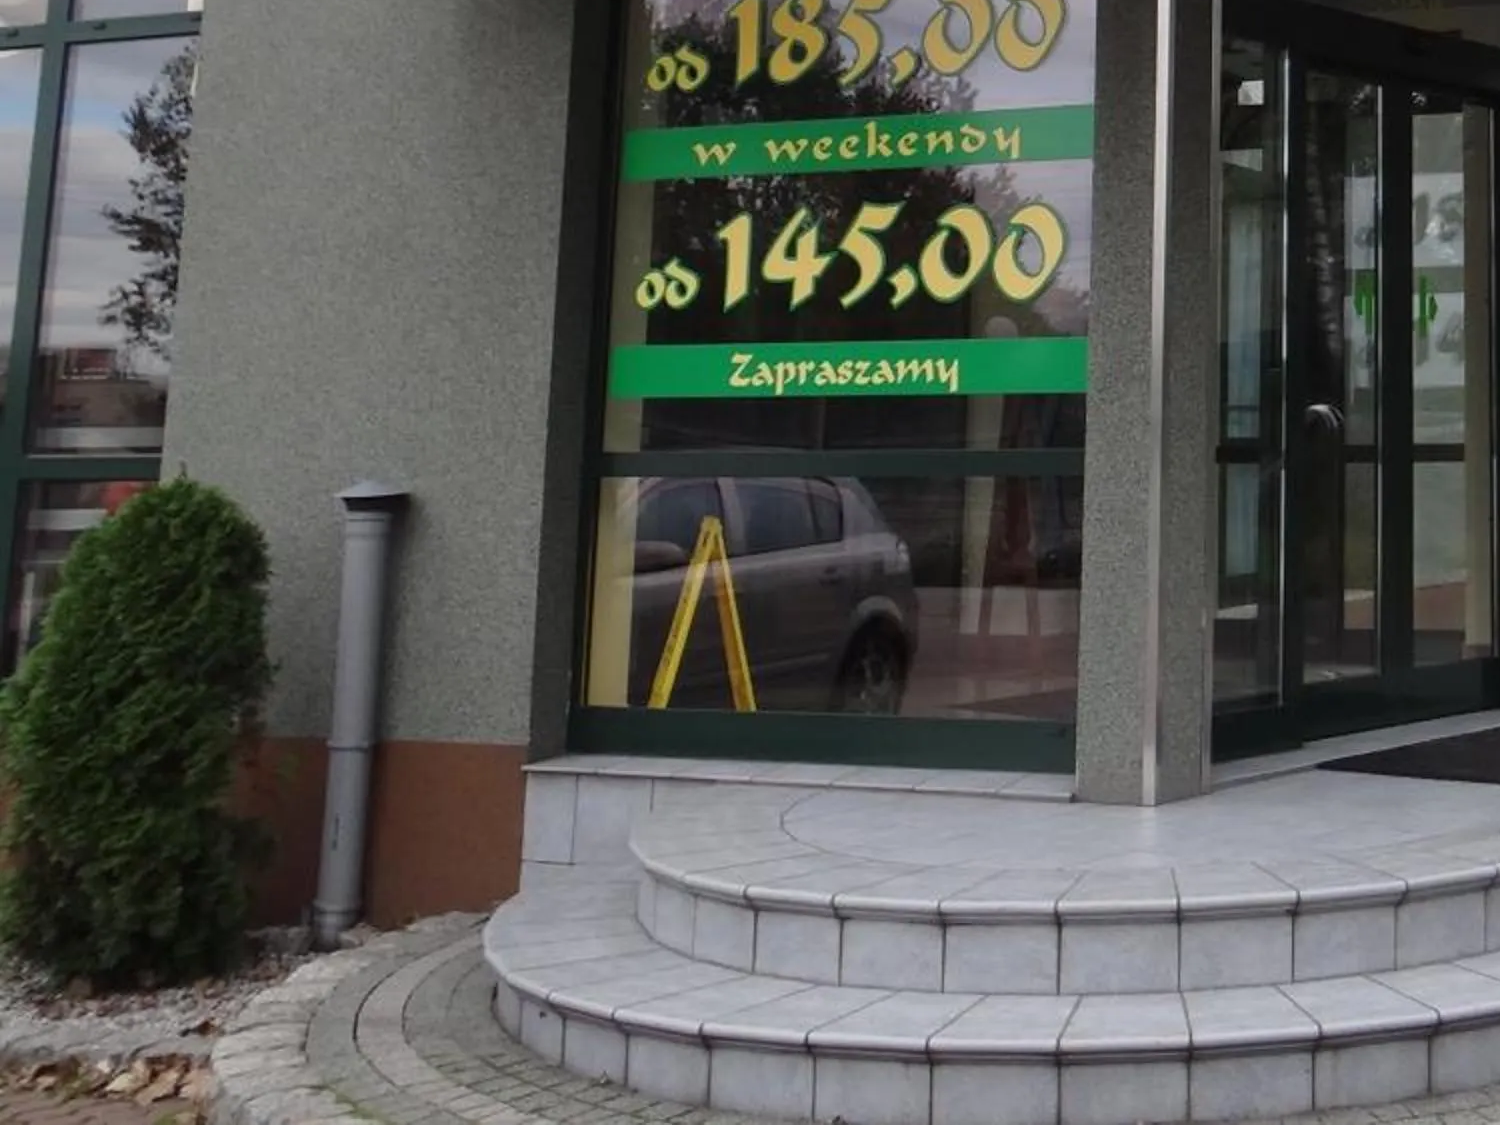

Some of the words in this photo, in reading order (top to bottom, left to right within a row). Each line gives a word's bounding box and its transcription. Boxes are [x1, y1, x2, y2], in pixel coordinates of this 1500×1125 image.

[692, 141, 737, 167] w
[764, 121, 1022, 163] weekendy
[716, 200, 1068, 313] 145,00
[728, 352, 961, 395] Zapraszamy
